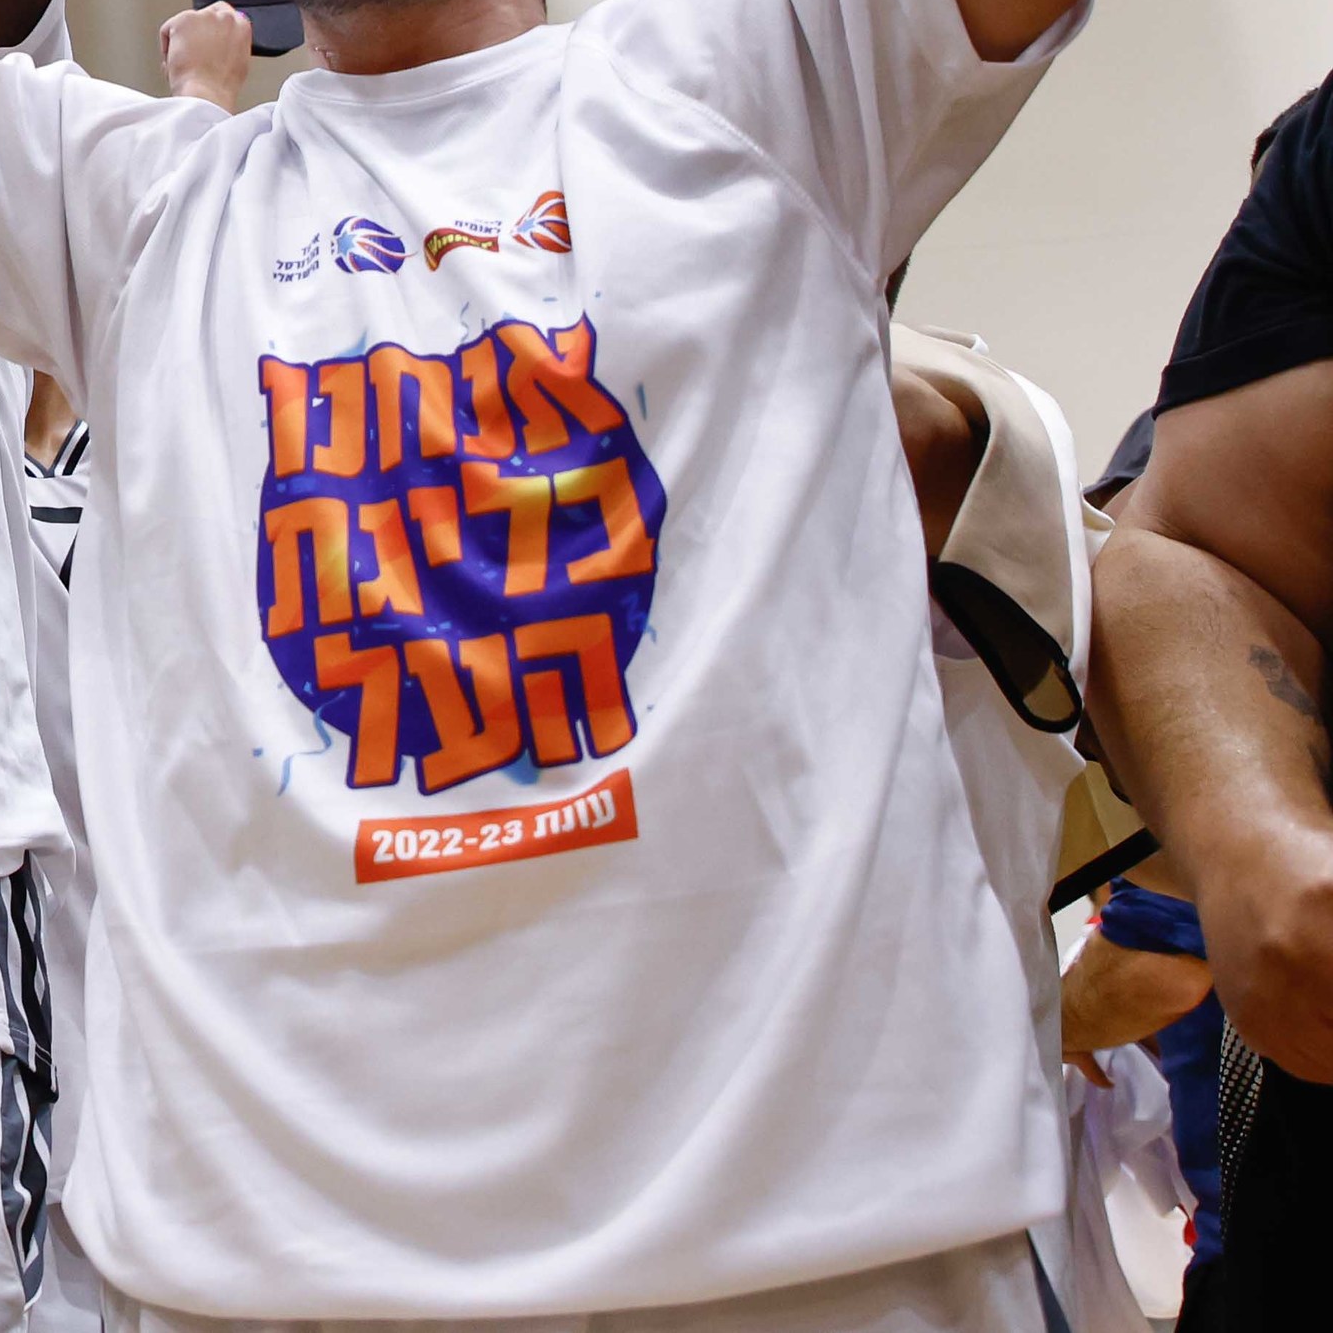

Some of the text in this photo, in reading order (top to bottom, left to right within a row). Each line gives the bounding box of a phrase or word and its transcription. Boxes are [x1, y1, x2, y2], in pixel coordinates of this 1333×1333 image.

[262, 319, 625, 477] אנחנו
[264, 456, 655, 637] בליגת
[315, 613, 635, 792] העל
[371, 790, 616, 864] עונת 2022-23
